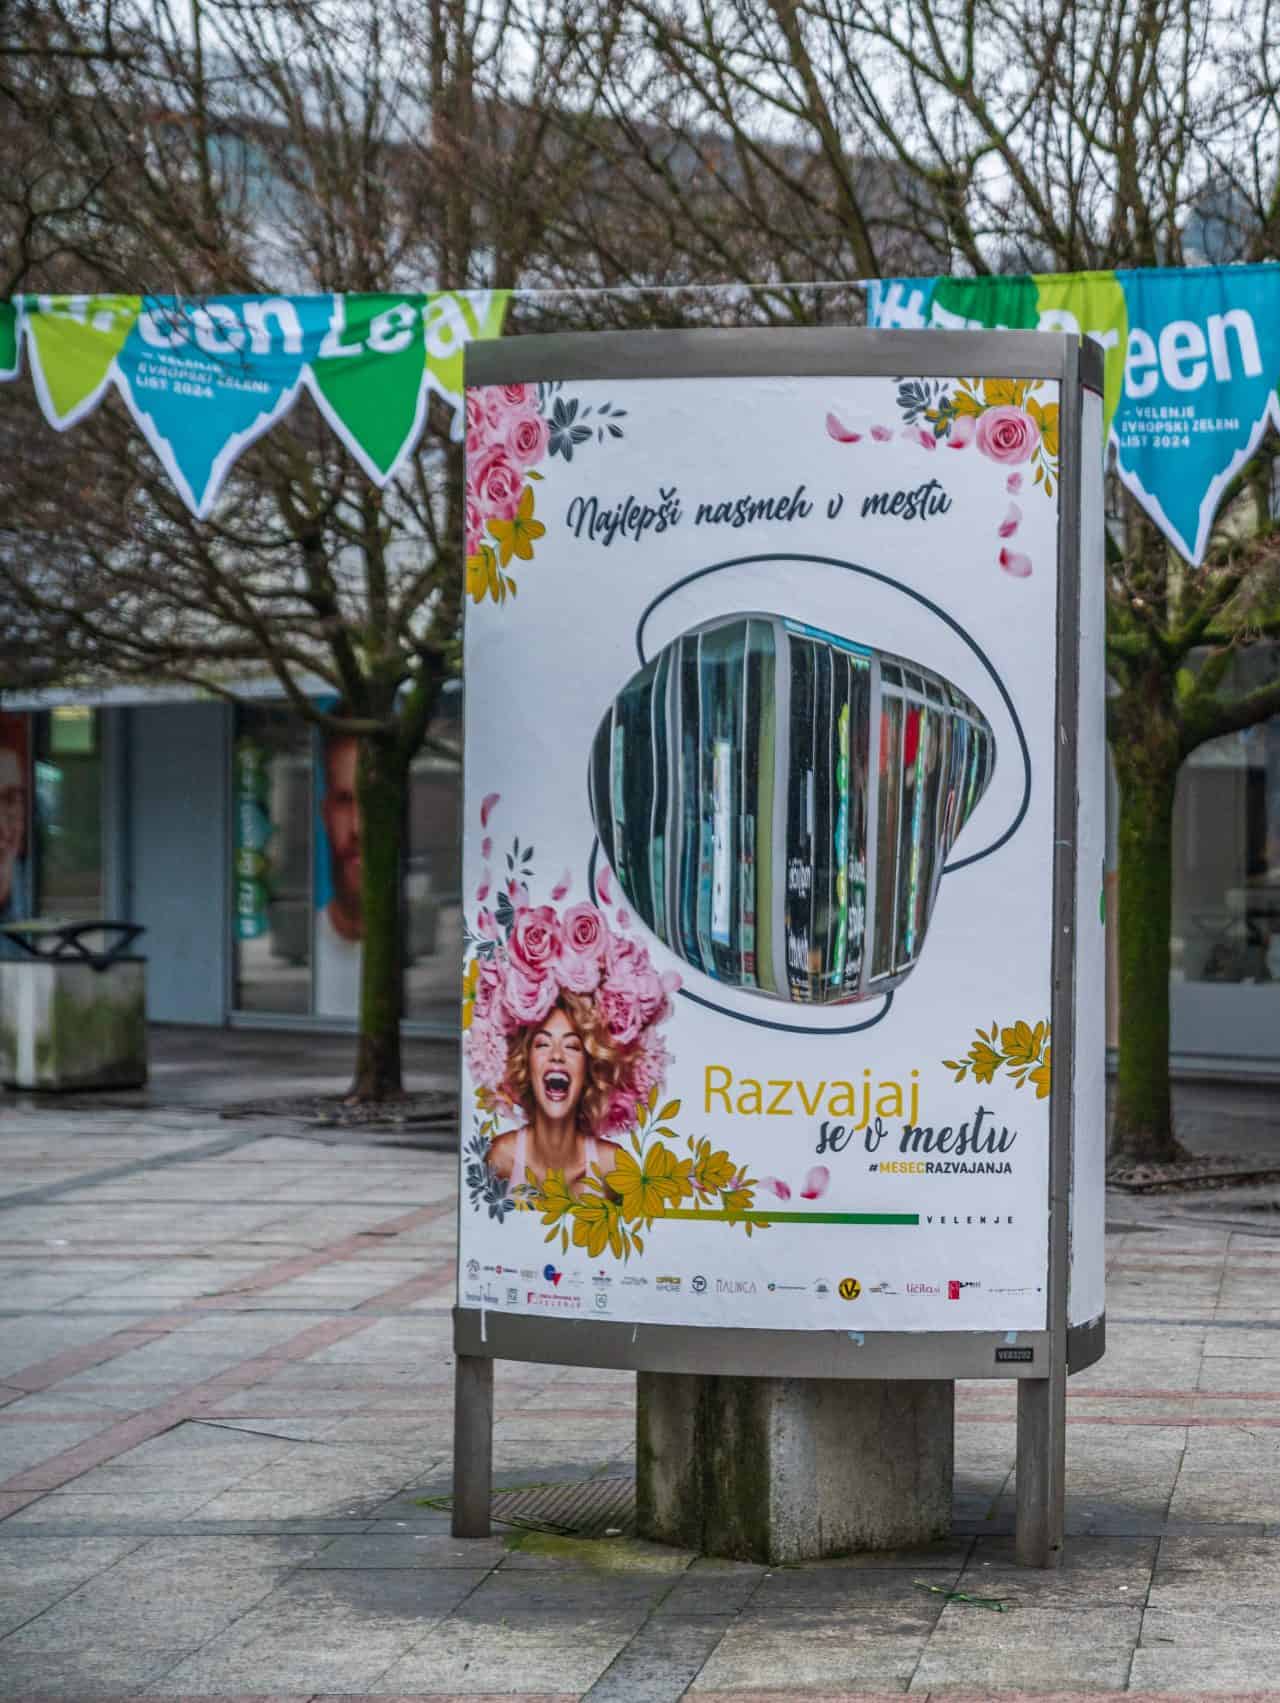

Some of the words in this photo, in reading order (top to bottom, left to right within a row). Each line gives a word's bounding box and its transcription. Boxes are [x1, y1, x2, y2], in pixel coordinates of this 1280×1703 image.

[135, 374, 169, 391] LIST
[1135, 405, 1196, 419] VELENJE
[1121, 419, 1189, 434] EVROPSKI
[1191, 417, 1240, 433] ZELENI
[1119, 434, 1149, 449] LIST
[1152, 434, 1191, 449] 2024
[566, 487, 683, 547] Najlepši
[694, 484, 815, 528] nasmeh
[826, 493, 844, 520] v
[861, 478, 953, 521] mestu
[703, 1064, 920, 1131] Razvajaj
[815, 1120, 854, 1155] se
[864, 1116, 889, 1154] v
[899, 1105, 1018, 1156] mestu
[868, 1161, 1013, 1175] #MESECRAZVAJANJA
[926, 1214, 1015, 1225] VELENJE
